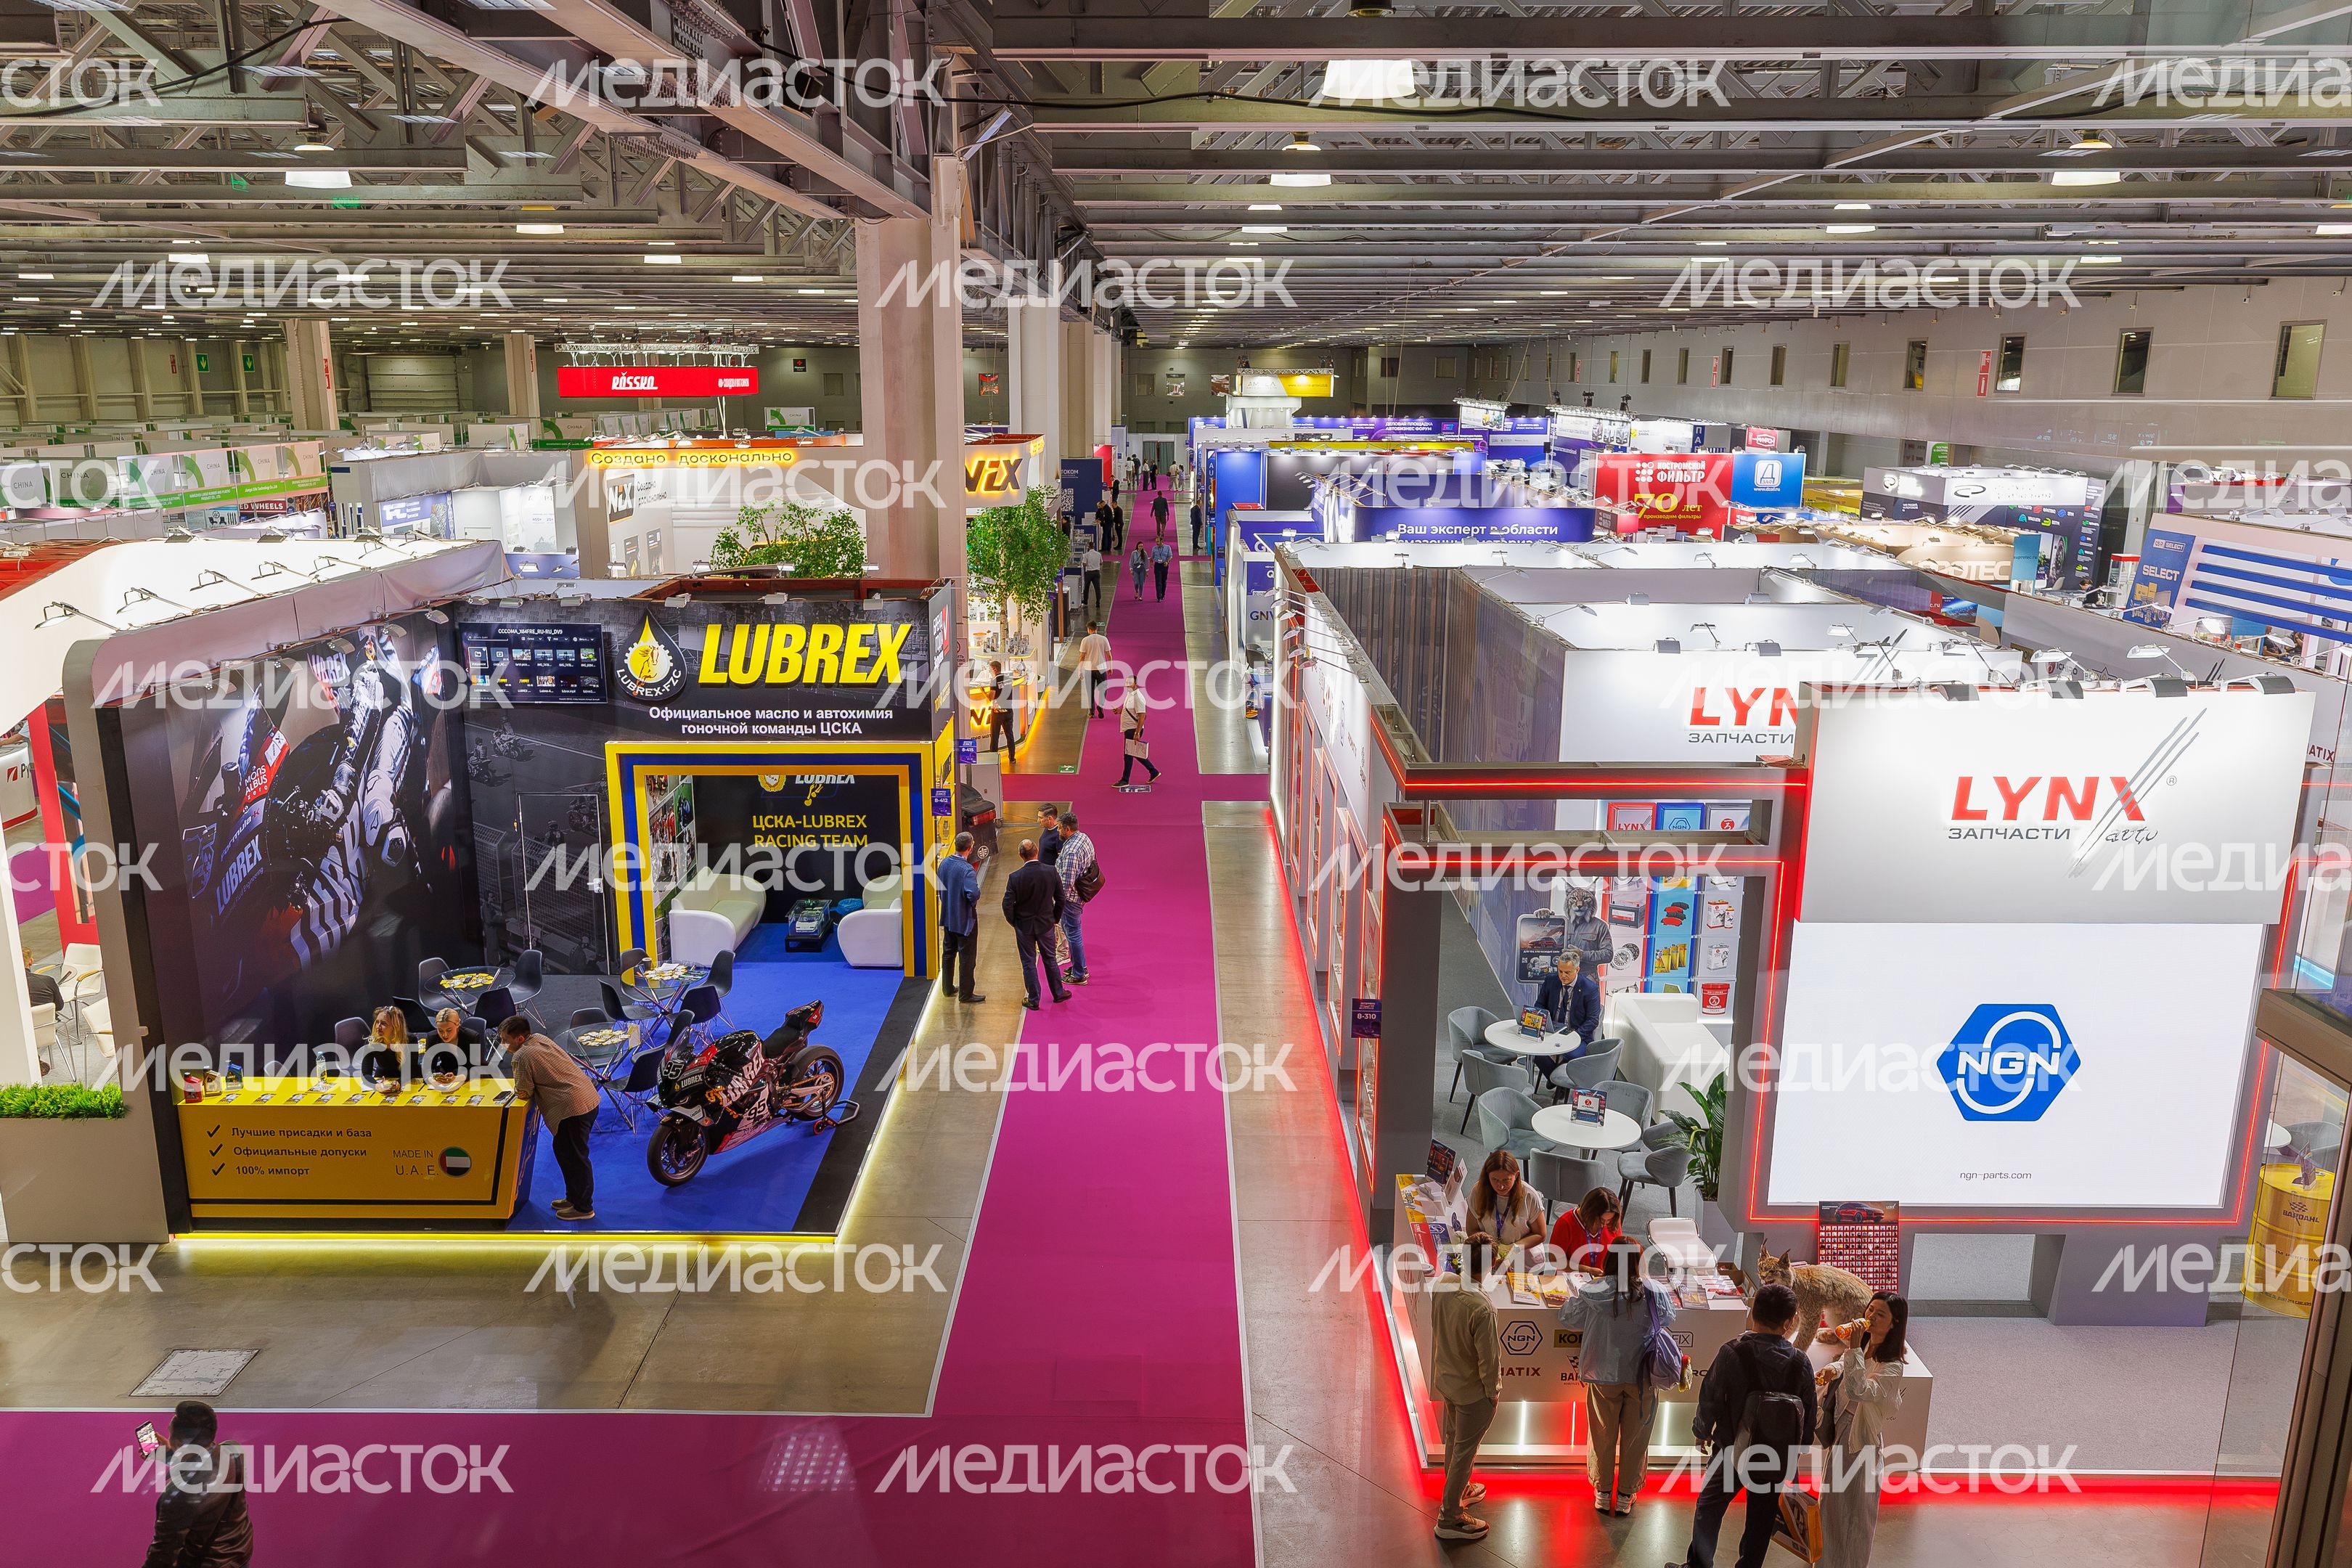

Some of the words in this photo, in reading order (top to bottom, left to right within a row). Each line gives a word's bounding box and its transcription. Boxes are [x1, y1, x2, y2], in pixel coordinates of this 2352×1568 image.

[591, 452, 666, 465] Создано
[679, 452, 792, 465] досконально
[1657, 460, 1705, 470] КОСТРОМСКОЙ
[1657, 470, 1705, 483] ФИЛЬТР
[13, 481, 33, 489] CHINA
[250, 500, 284, 510] WHEELS
[1633, 493, 1678, 519] 70
[1397, 523, 1427, 534] Ваш
[1430, 526, 1487, 537] эксперт
[1502, 523, 1559, 535] области
[2142, 564, 2180, 581] SELECT
[698, 624, 912, 684] LUBREX
[2056, 662, 2078, 675] ICHIRO
[616, 669, 682, 697] LUBREX-FZC
[649, 707, 751, 722] Официальное
[756, 709, 799, 719] масло
[804, 709, 812, 719] и
[816, 709, 893, 720] автохимия
[682, 722, 748, 734] гоночной
[752, 724, 815, 736] команды
[820, 722, 862, 736] ЦСКА
[1688, 732, 1794, 744] ЗАПЧАСТИ
[245, 775, 268, 796] ALBUS
[1951, 776, 2145, 821] LYNX
[753, 814, 867, 830] ЦСКА-LUBREX
[754, 835, 816, 847] RACING
[820, 835, 867, 847] TEAM
[1948, 828, 2070, 840] ЗАПЧАСТИ
[216, 834, 262, 915] LUBREX
[662, 1061, 683, 1079] 95
[1957, 1051, 2060, 1075] NGN
[681, 1074, 703, 1088] LUBREX
[748, 1099, 766, 1121] 95
[232, 1127, 275, 1138] Лучшие
[279, 1129, 332, 1139] присадки
[346, 1128, 372, 1138] база
[233, 1146, 317, 1157] Официальные
[320, 1148, 367, 1158] допуски
[235, 1166, 264, 1175] 100%
[268, 1167, 309, 1176] импорт
[1959, 1172, 2032, 1181] ngn-parts.com
[2282, 1209, 2320, 1223] BARDAHL
